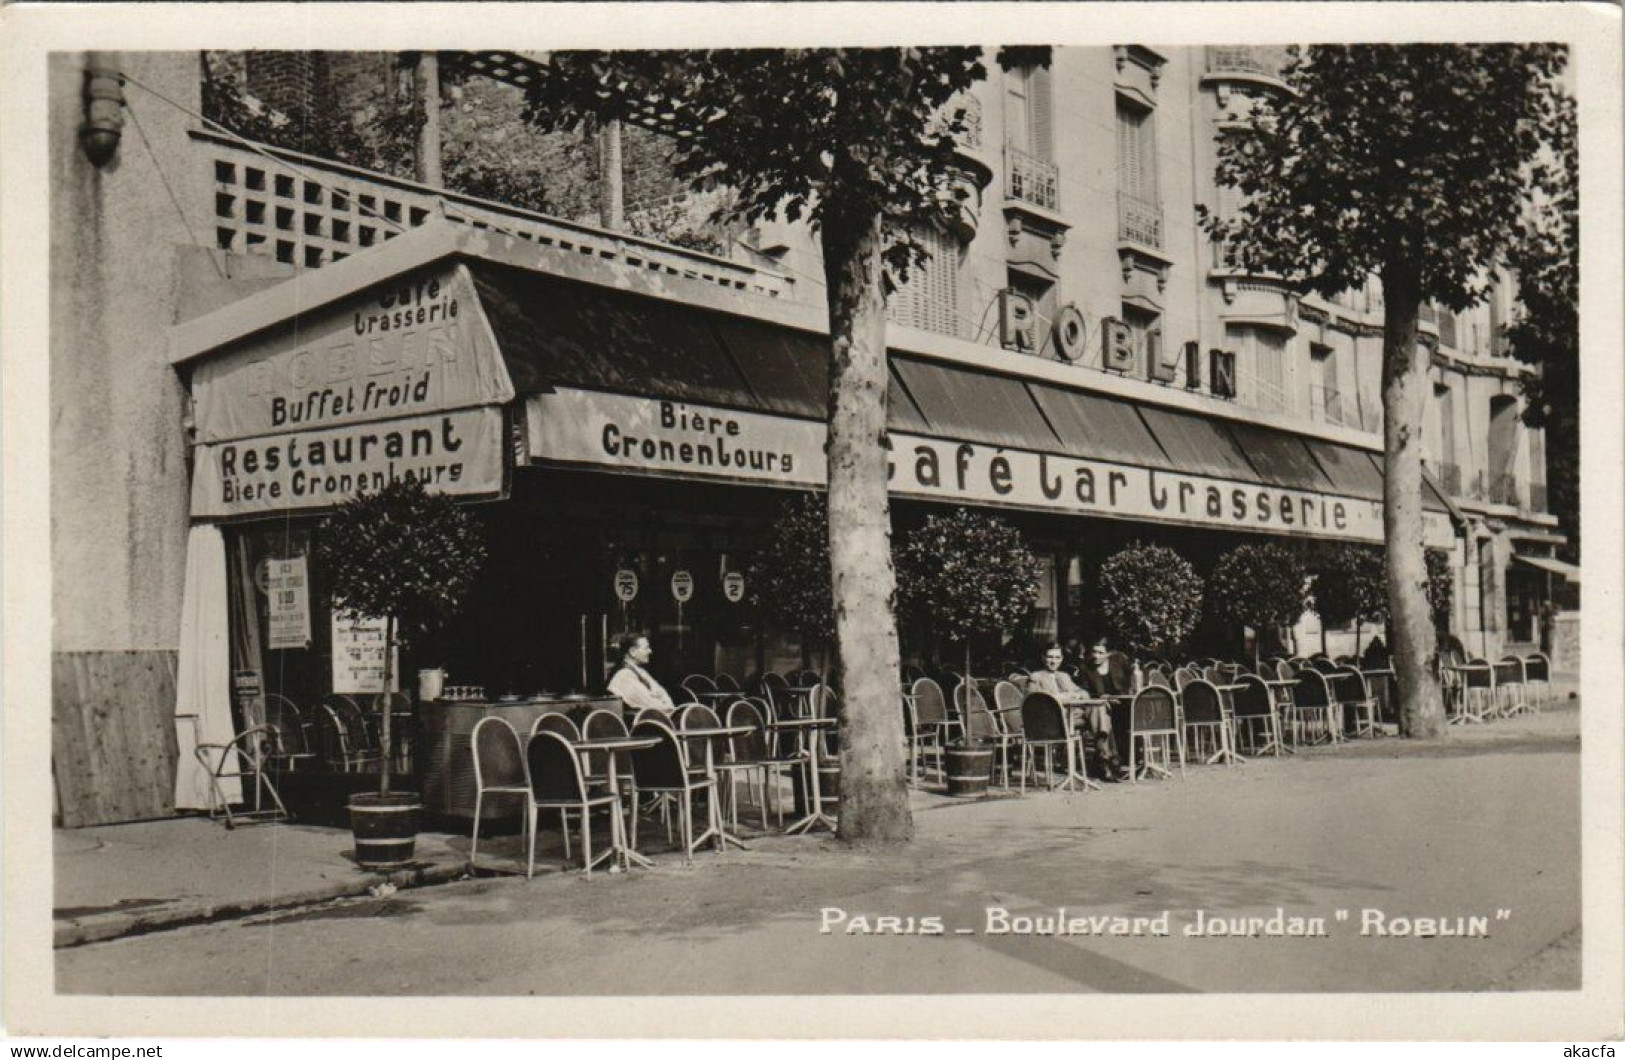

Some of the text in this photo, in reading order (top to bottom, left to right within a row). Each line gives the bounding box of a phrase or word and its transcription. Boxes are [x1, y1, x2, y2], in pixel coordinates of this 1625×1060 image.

[1001, 286, 1236, 400] ROBLIN
[271, 372, 430, 427] Buffet froid
[660, 401, 741, 436] Bière
[221, 417, 463, 477] Restaurant
